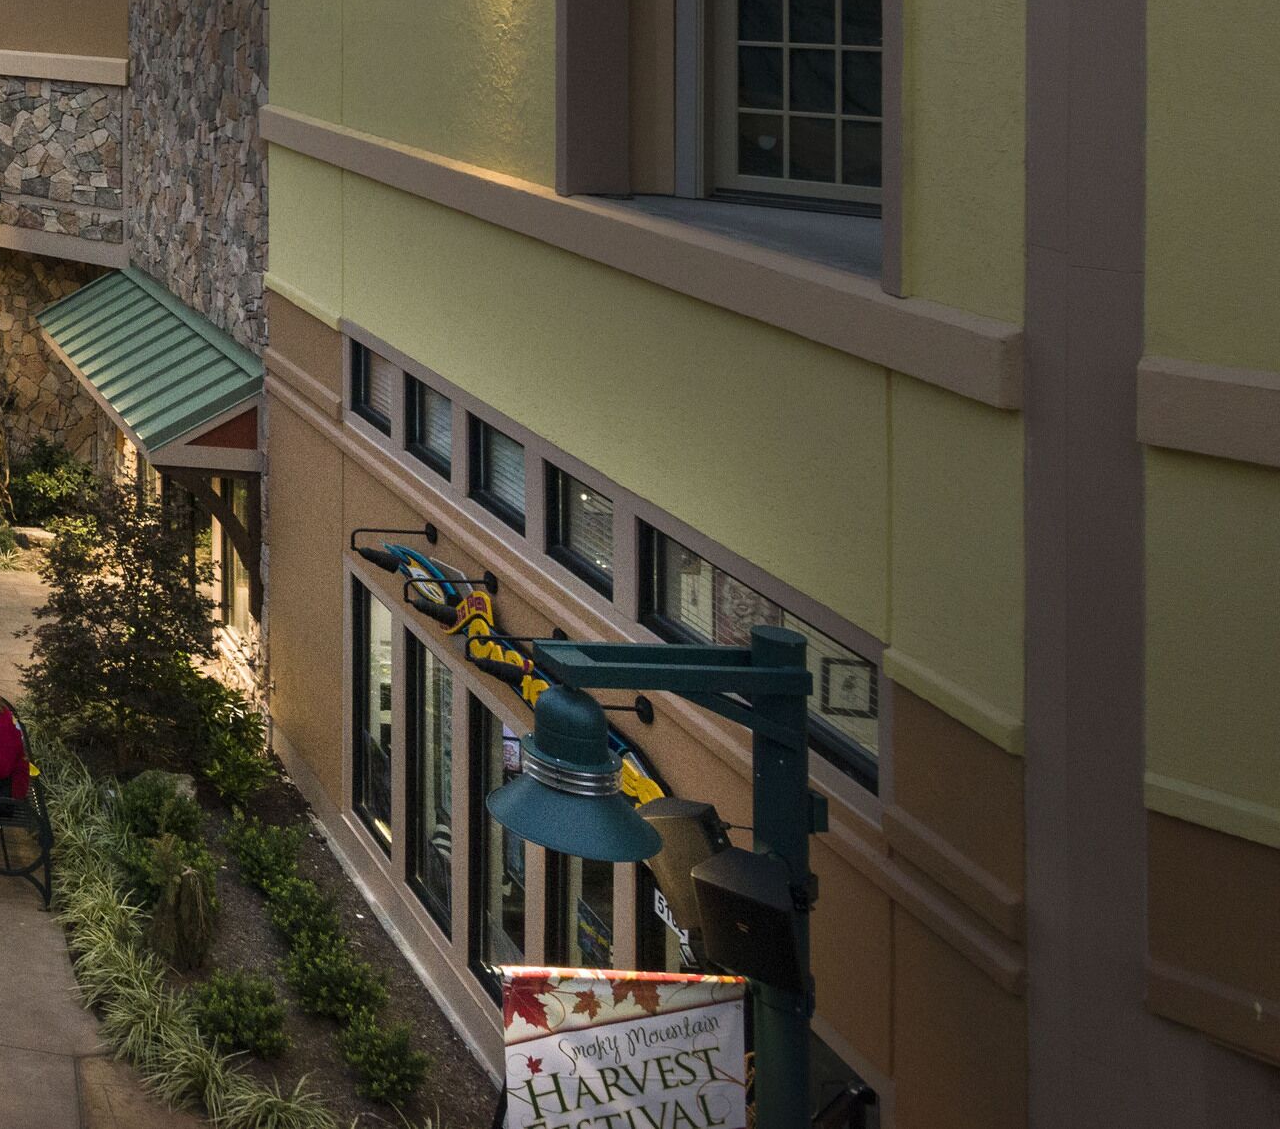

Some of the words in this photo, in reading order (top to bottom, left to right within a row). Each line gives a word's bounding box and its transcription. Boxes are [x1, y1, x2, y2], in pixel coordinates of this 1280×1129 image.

[657, 895, 686, 936] 51
[558, 1034, 620, 1076] Smoky
[624, 1014, 720, 1056] Mountain
[523, 1046, 721, 1120] HARVEST
